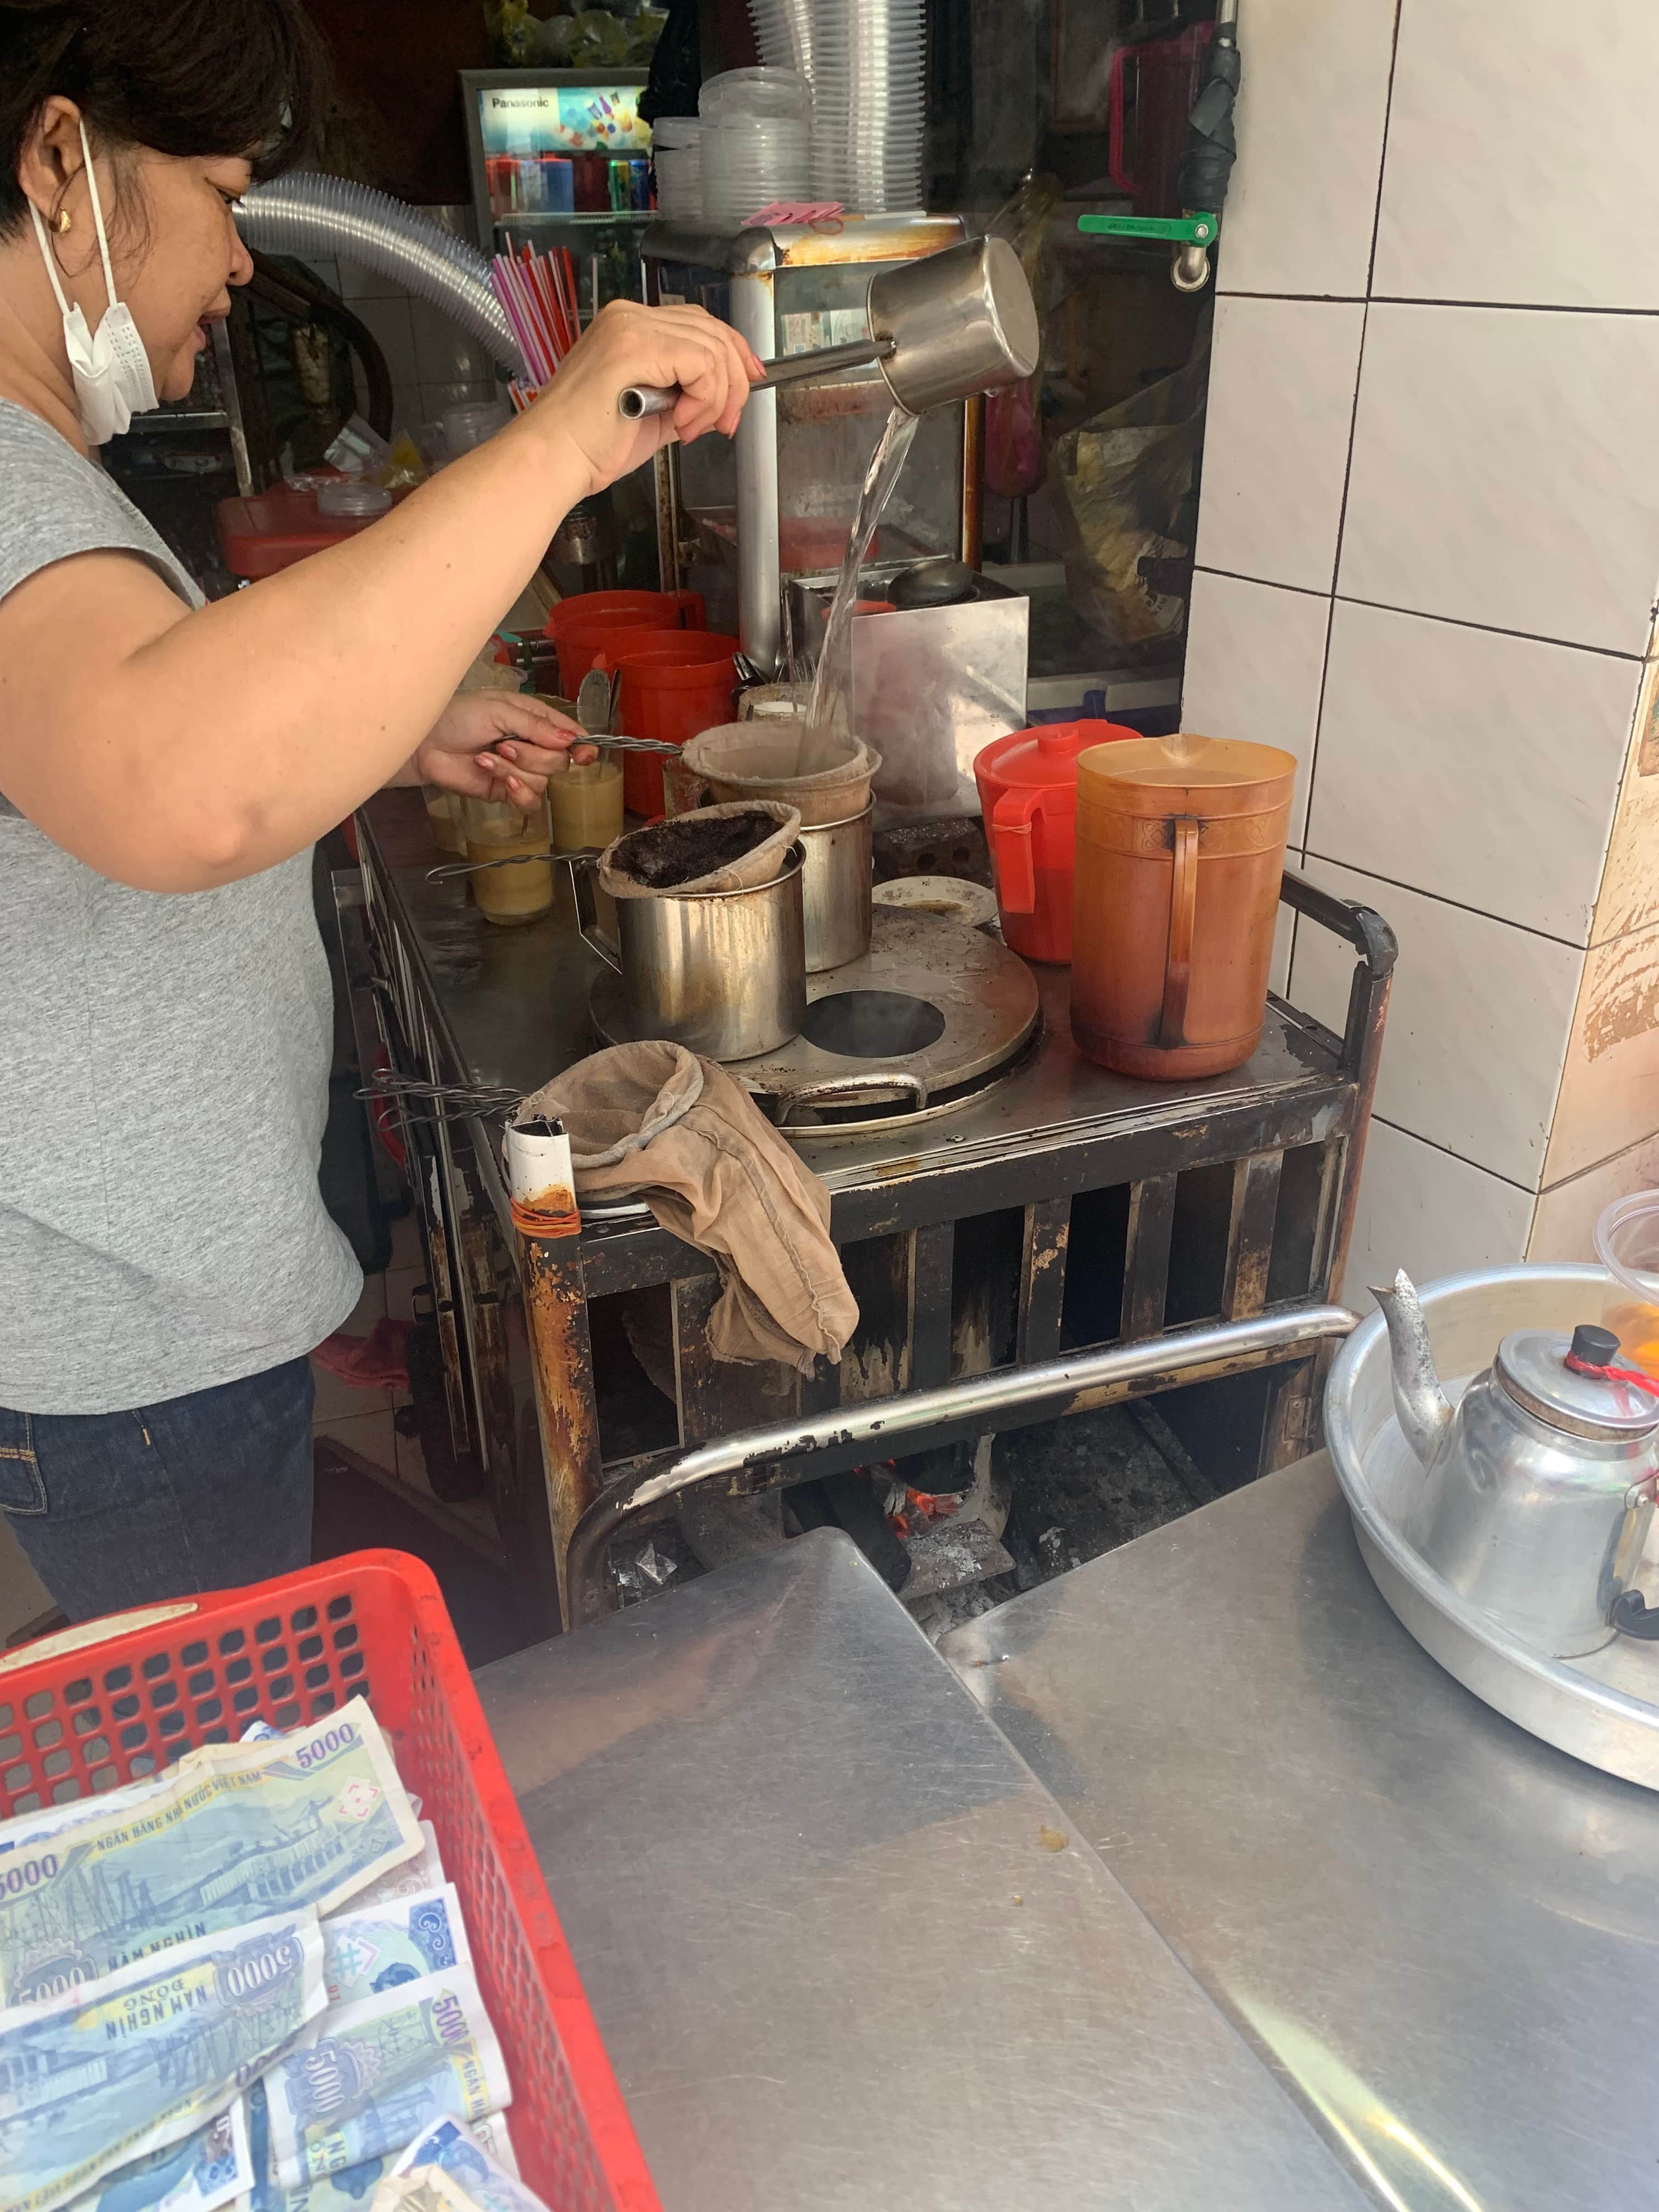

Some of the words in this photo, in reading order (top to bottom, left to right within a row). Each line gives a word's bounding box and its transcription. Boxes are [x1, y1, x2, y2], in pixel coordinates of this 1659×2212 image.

[492, 97, 549, 108] Panasonic
[296, 1723, 354, 1769] 5000
[97, 1829, 129, 1852] NGÂN
[132, 1816, 162, 1838] HÀNG
[238, 1770, 262, 1785] NAM
[227, 1945, 293, 1998] 5000
[105, 2001, 166, 2041] NGHÌN
[304, 2050, 345, 2113] 5000
